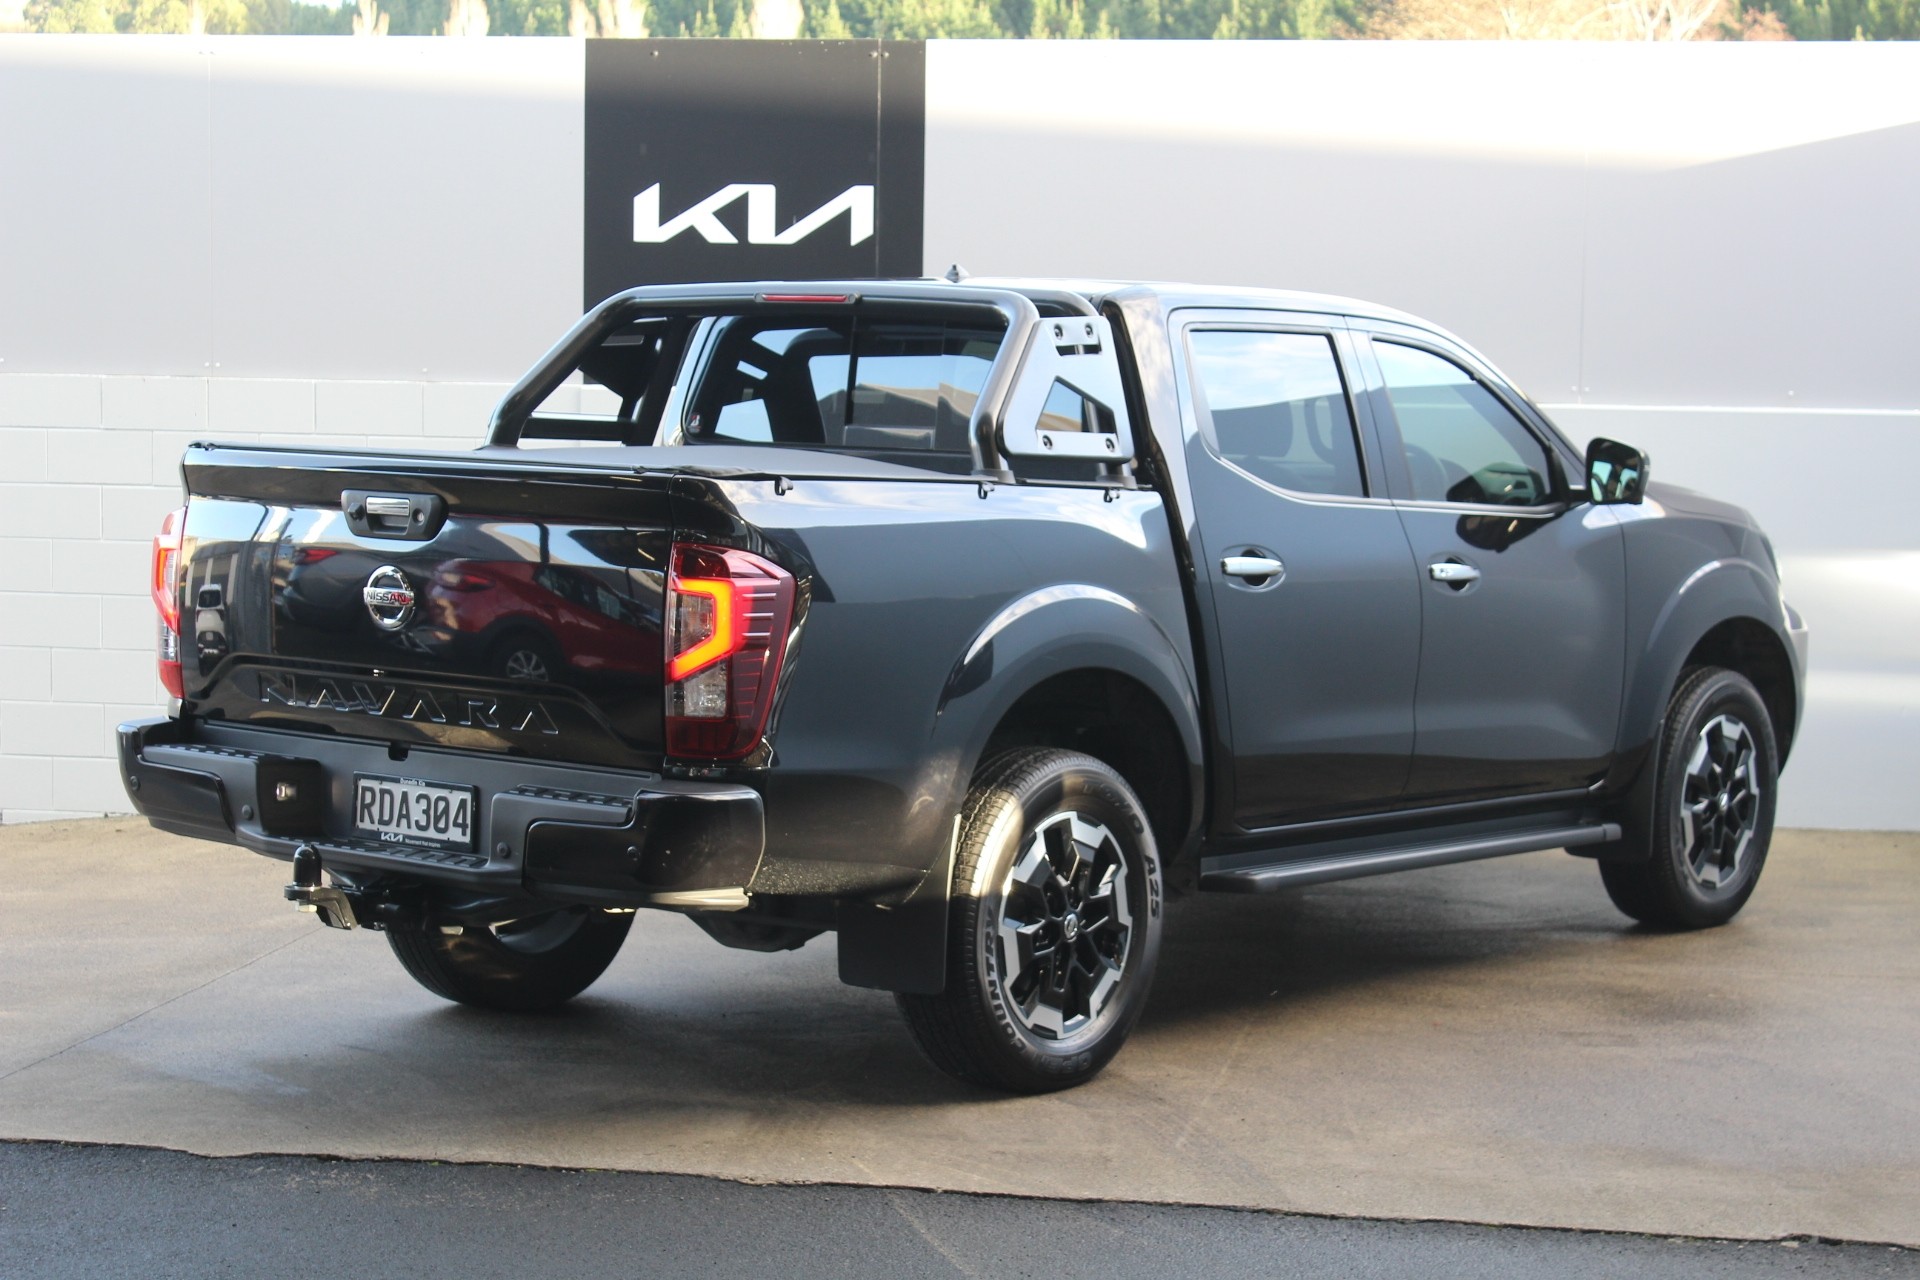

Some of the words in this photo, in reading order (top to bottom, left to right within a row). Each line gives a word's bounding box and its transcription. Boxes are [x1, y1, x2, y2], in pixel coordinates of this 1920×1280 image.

[633, 182, 874, 246] KIA
[366, 590, 406, 603] NISSAN
[259, 671, 559, 735] NAVARA
[359, 785, 469, 837] RDA304
[381, 832, 403, 842] KIA
[1144, 855, 1160, 919] A25
[983, 906, 1028, 1052] COUNTRY
